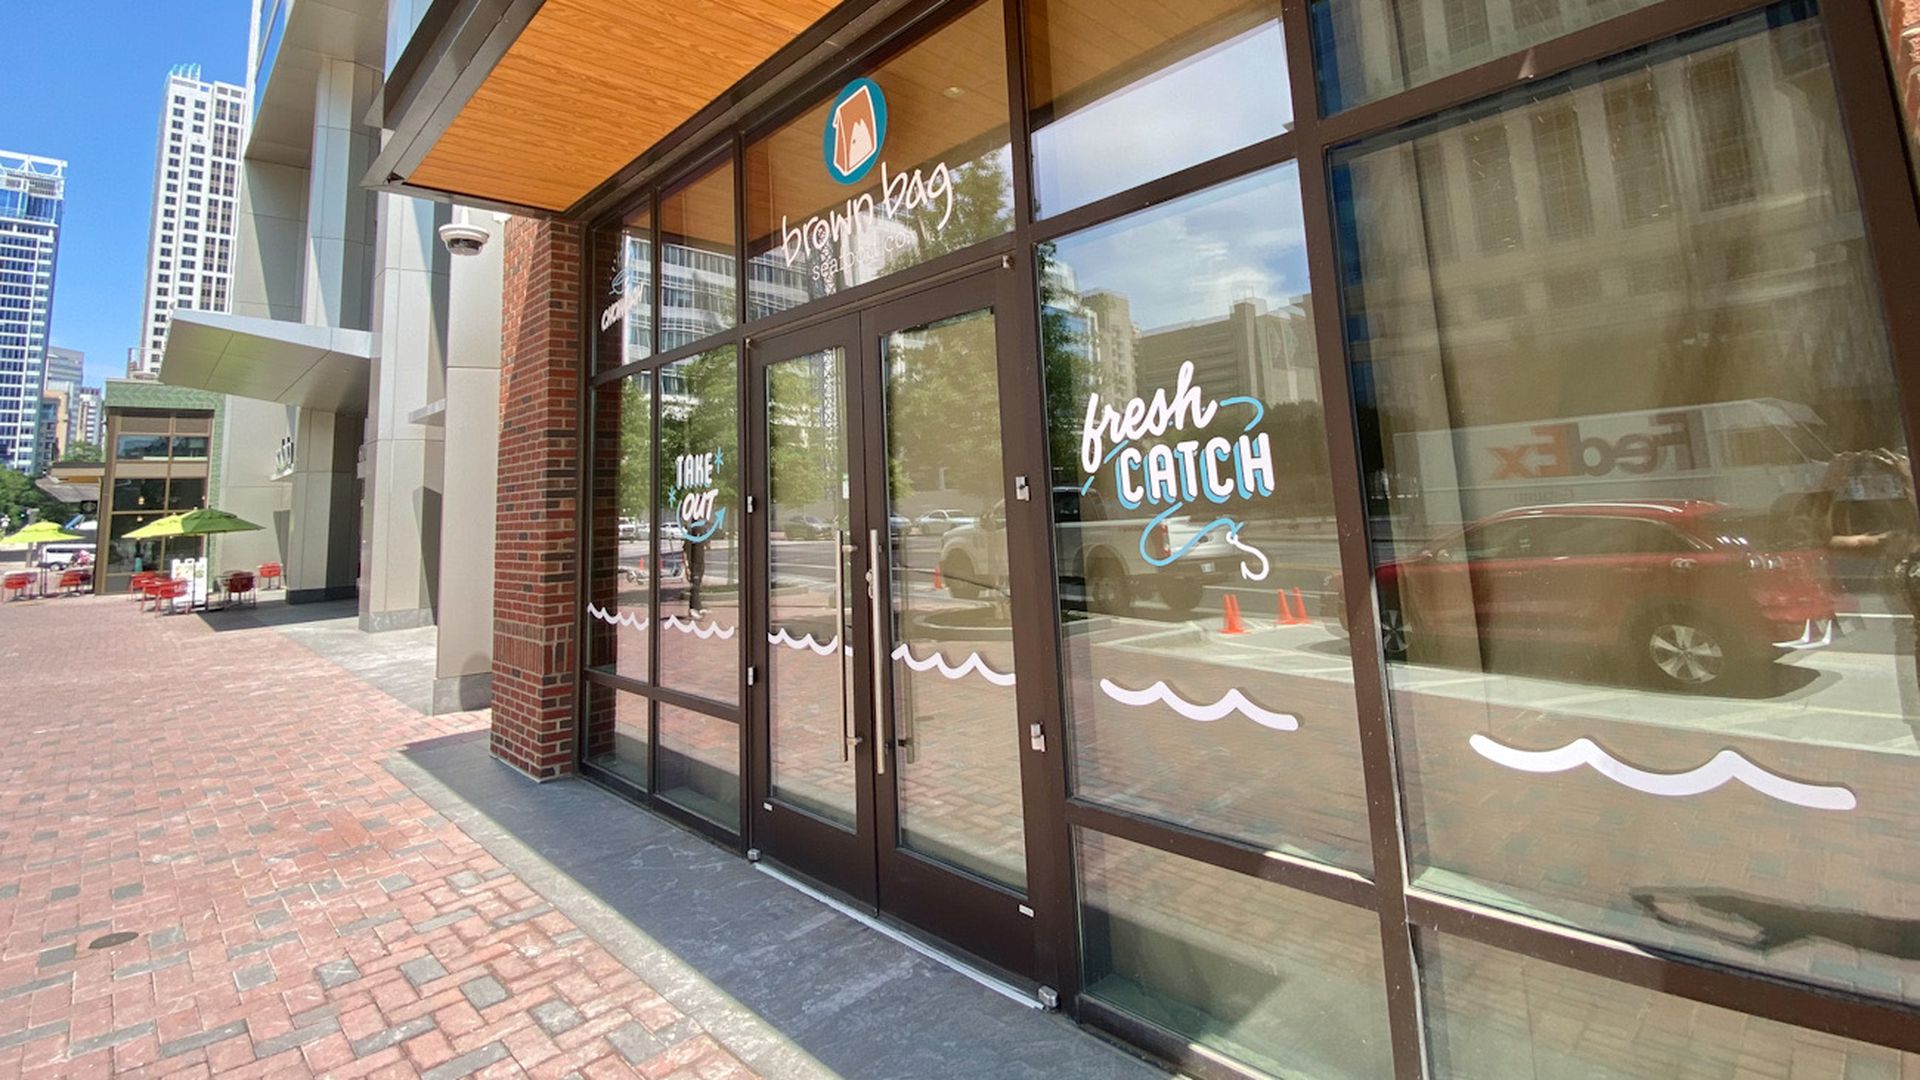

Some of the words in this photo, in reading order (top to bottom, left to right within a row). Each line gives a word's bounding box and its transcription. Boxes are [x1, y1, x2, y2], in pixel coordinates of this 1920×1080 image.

[781, 193, 874, 267] brown
[881, 161, 953, 231] bag
[1081, 359, 1219, 474] fresh
[675, 452, 713, 490] TAKE
[682, 488, 719, 521] OUT
[1116, 432, 1275, 510] CATCH
